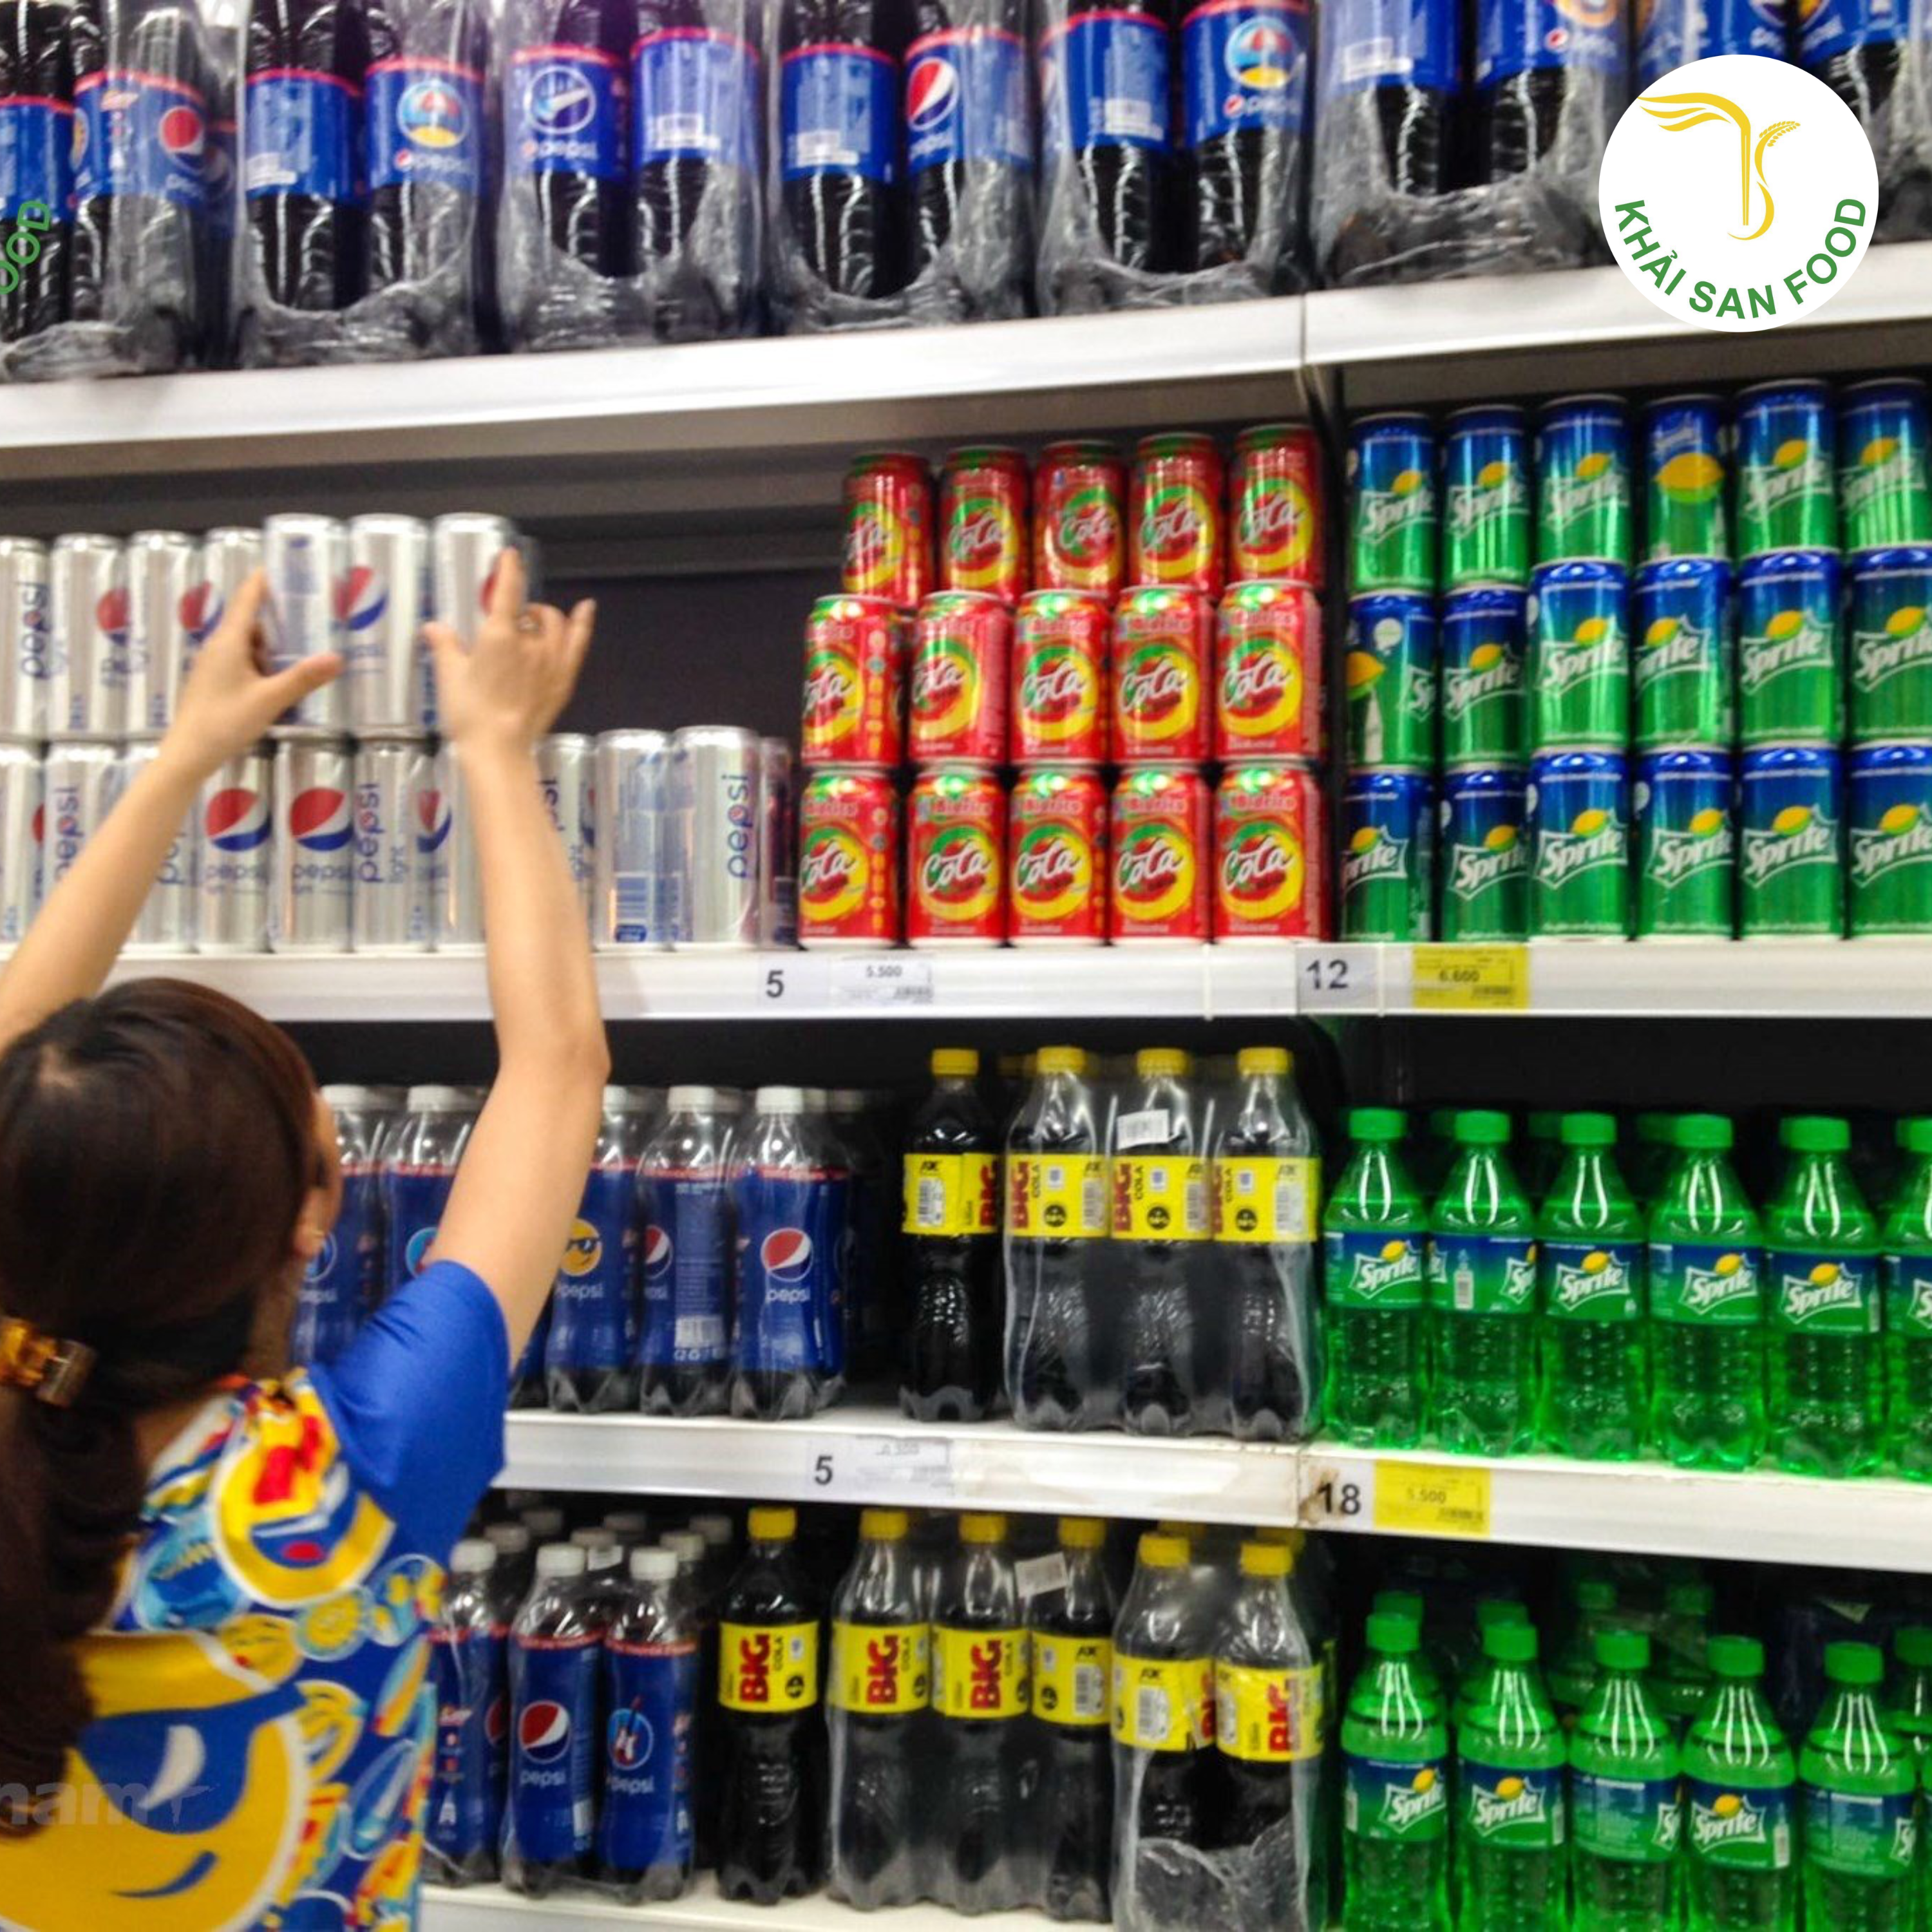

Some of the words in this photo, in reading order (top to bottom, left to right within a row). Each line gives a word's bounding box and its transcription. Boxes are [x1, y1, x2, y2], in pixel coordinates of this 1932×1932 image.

[1540, 639, 1624, 688] Sprite
[1741, 630, 1823, 684] Sprite
[1121, 654, 1189, 714] Cola
[358, 783, 384, 883] pepsi
[722, 773, 753, 878] pepsi
[1743, 824, 1830, 877] Sprite
[923, 837, 992, 893] Cola
[1017, 837, 1082, 891] Cola
[1116, 837, 1183, 892] Cola
[1225, 836, 1293, 891] Cola
[1540, 826, 1621, 877] Sprite
[766, 969, 784, 998] 5
[1307, 960, 1349, 989] 12
[766, 1288, 810, 1303] pepsi
[1558, 1264, 1624, 1302] Sprite
[1687, 1267, 1751, 1305] Sprite
[1783, 1276, 1853, 1315] Sprite
[815, 1455, 833, 1485] 5
[1318, 1482, 1361, 1515] 18
[740, 1634, 770, 1702] BIG
[867, 1635, 898, 1703] BIG
[971, 1640, 1001, 1710] BIG
[520, 1770, 565, 1788] pepsi
[611, 1777, 654, 1794] pepsi
[1473, 1790, 1537, 1828] Sprite
[1693, 1811, 1757, 1845] Sprite
